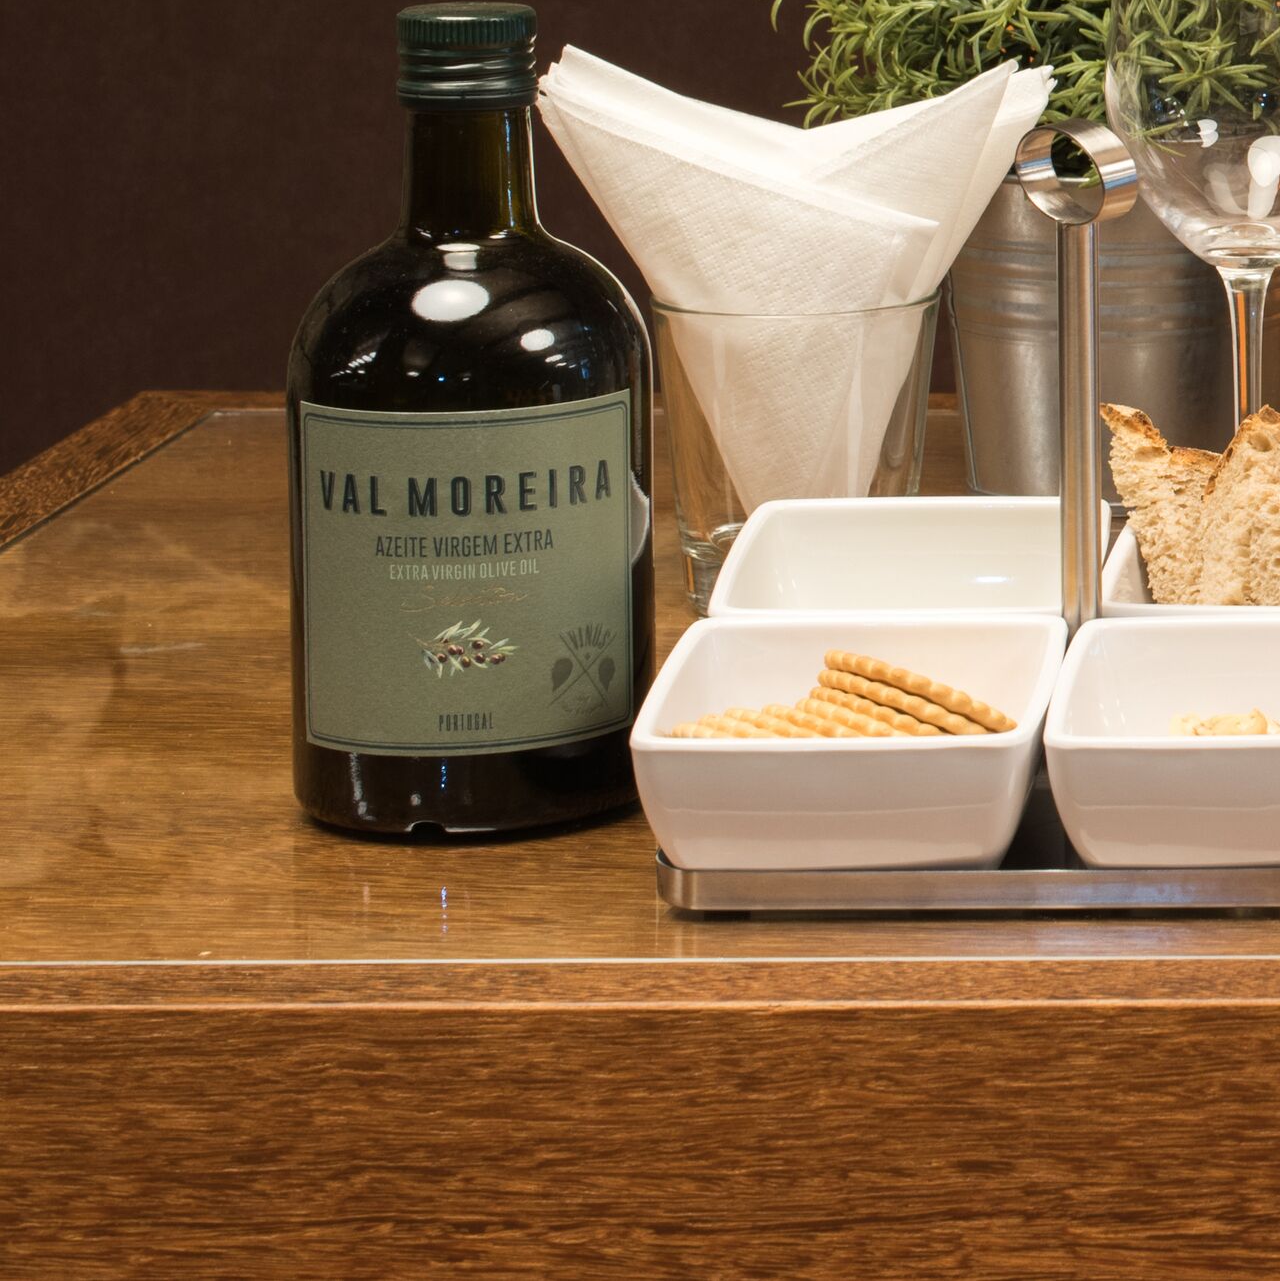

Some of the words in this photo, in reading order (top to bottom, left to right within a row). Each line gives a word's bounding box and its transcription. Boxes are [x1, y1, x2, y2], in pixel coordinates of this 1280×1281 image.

[320, 470, 387, 516] VAL
[408, 460, 611, 517] MOREIRA
[375, 535, 428, 559] AZEITE
[433, 534, 498, 558] VIRGEM
[504, 529, 554, 555] EXTRA
[389, 563, 429, 580] EXTRA
[431, 563, 476, 580] VIRGIN
[479, 560, 517, 579] OLIVE
[519, 559, 540, 576] OIL
[567, 622, 611, 650] VINUS
[438, 712, 494, 732] PORTUGAL
